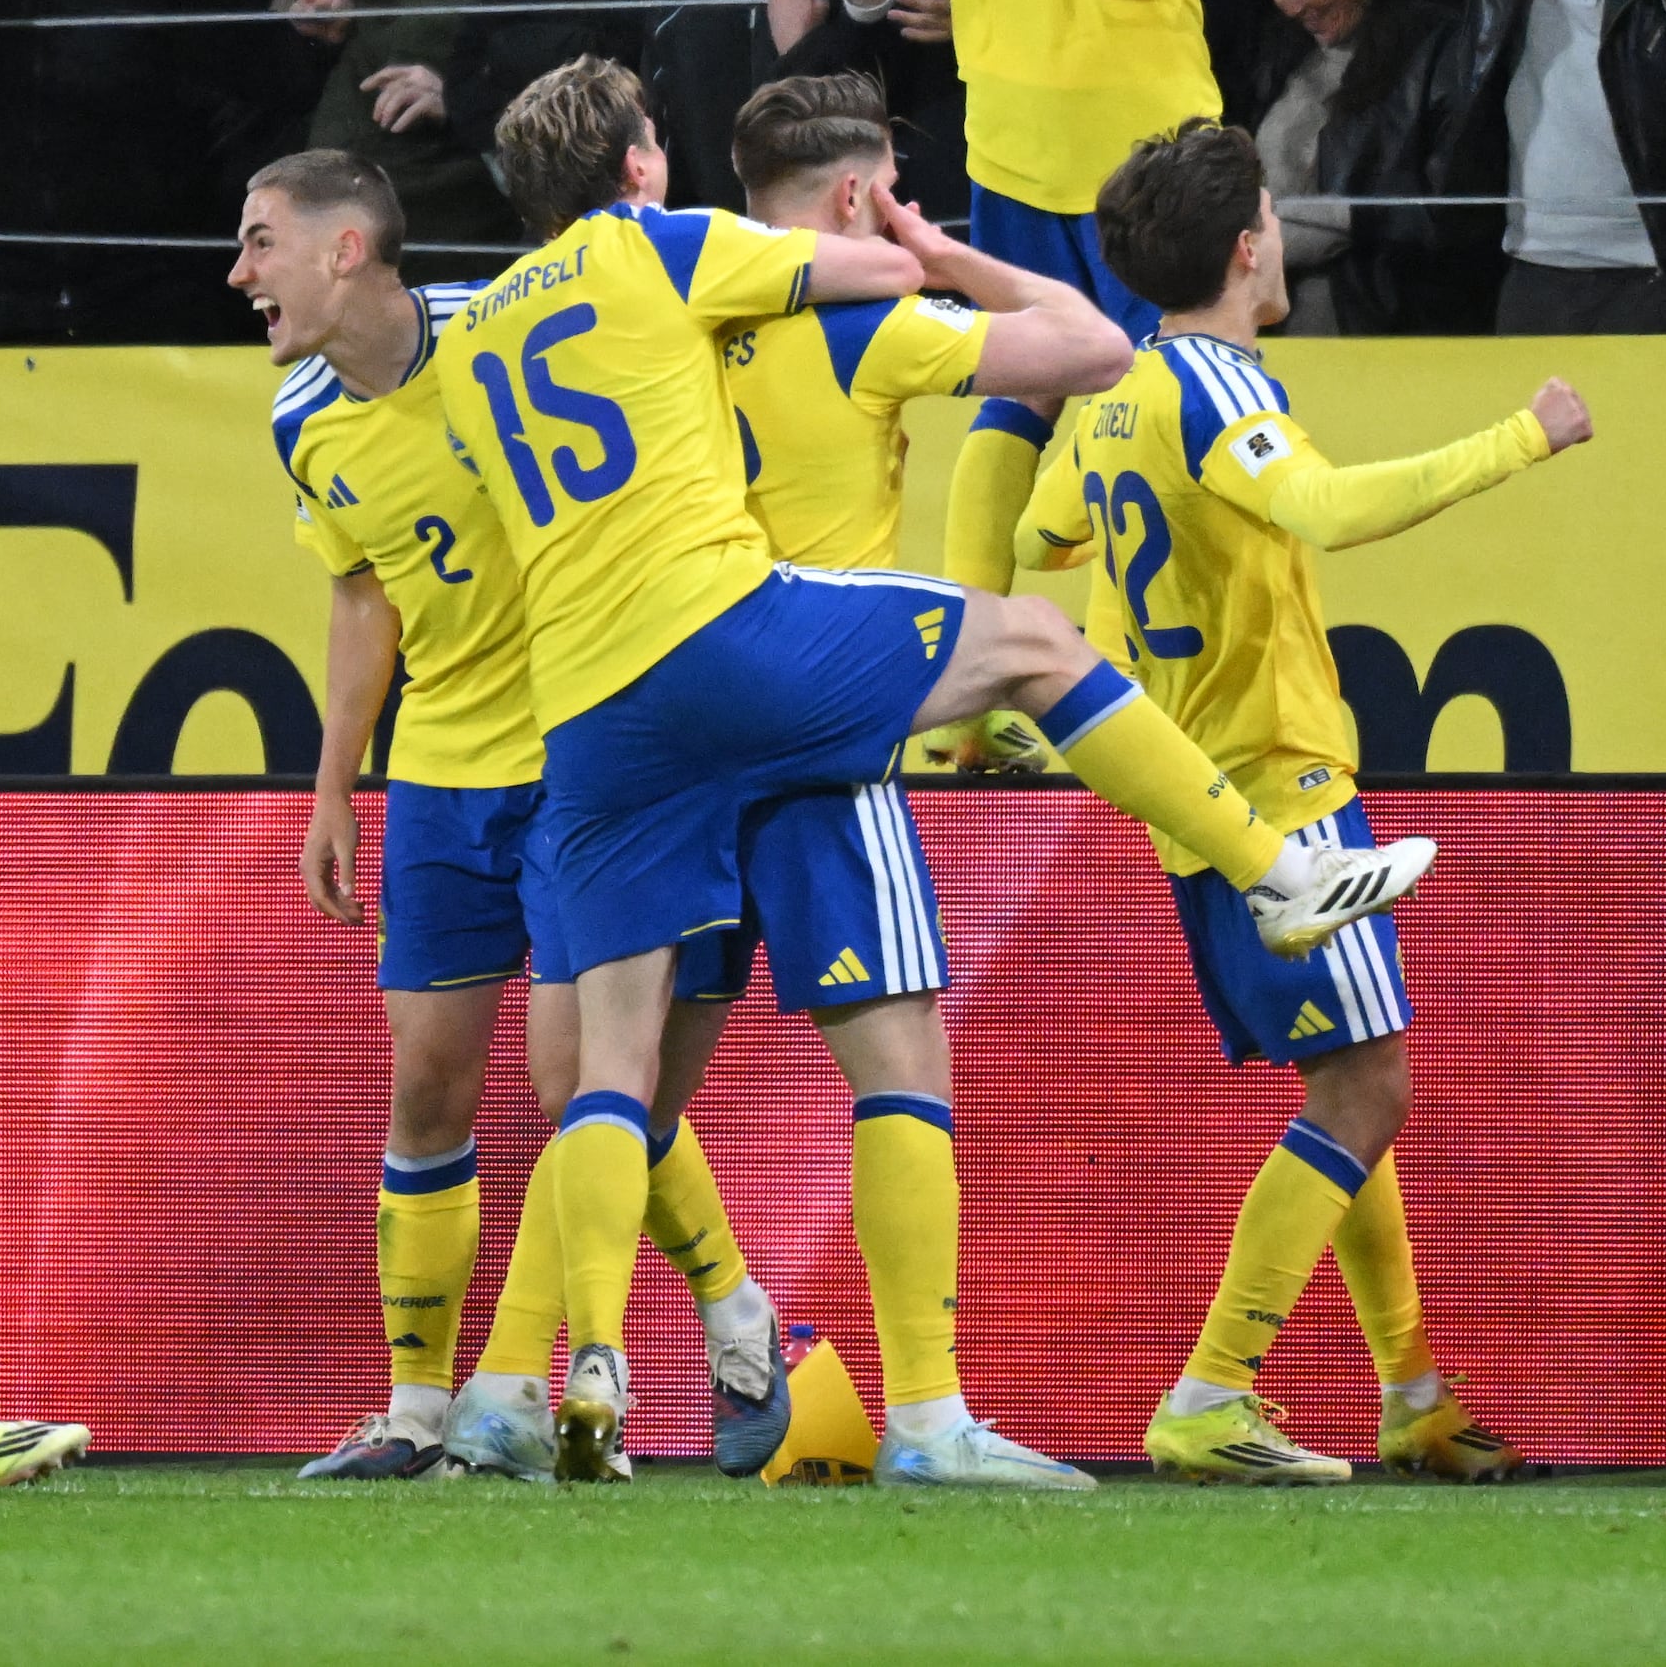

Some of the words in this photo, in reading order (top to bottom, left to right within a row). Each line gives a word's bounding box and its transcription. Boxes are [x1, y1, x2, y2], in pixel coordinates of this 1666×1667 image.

[466, 245, 588, 332] STARFELT
[472, 302, 637, 527] 15
[414, 515, 474, 584] 2
